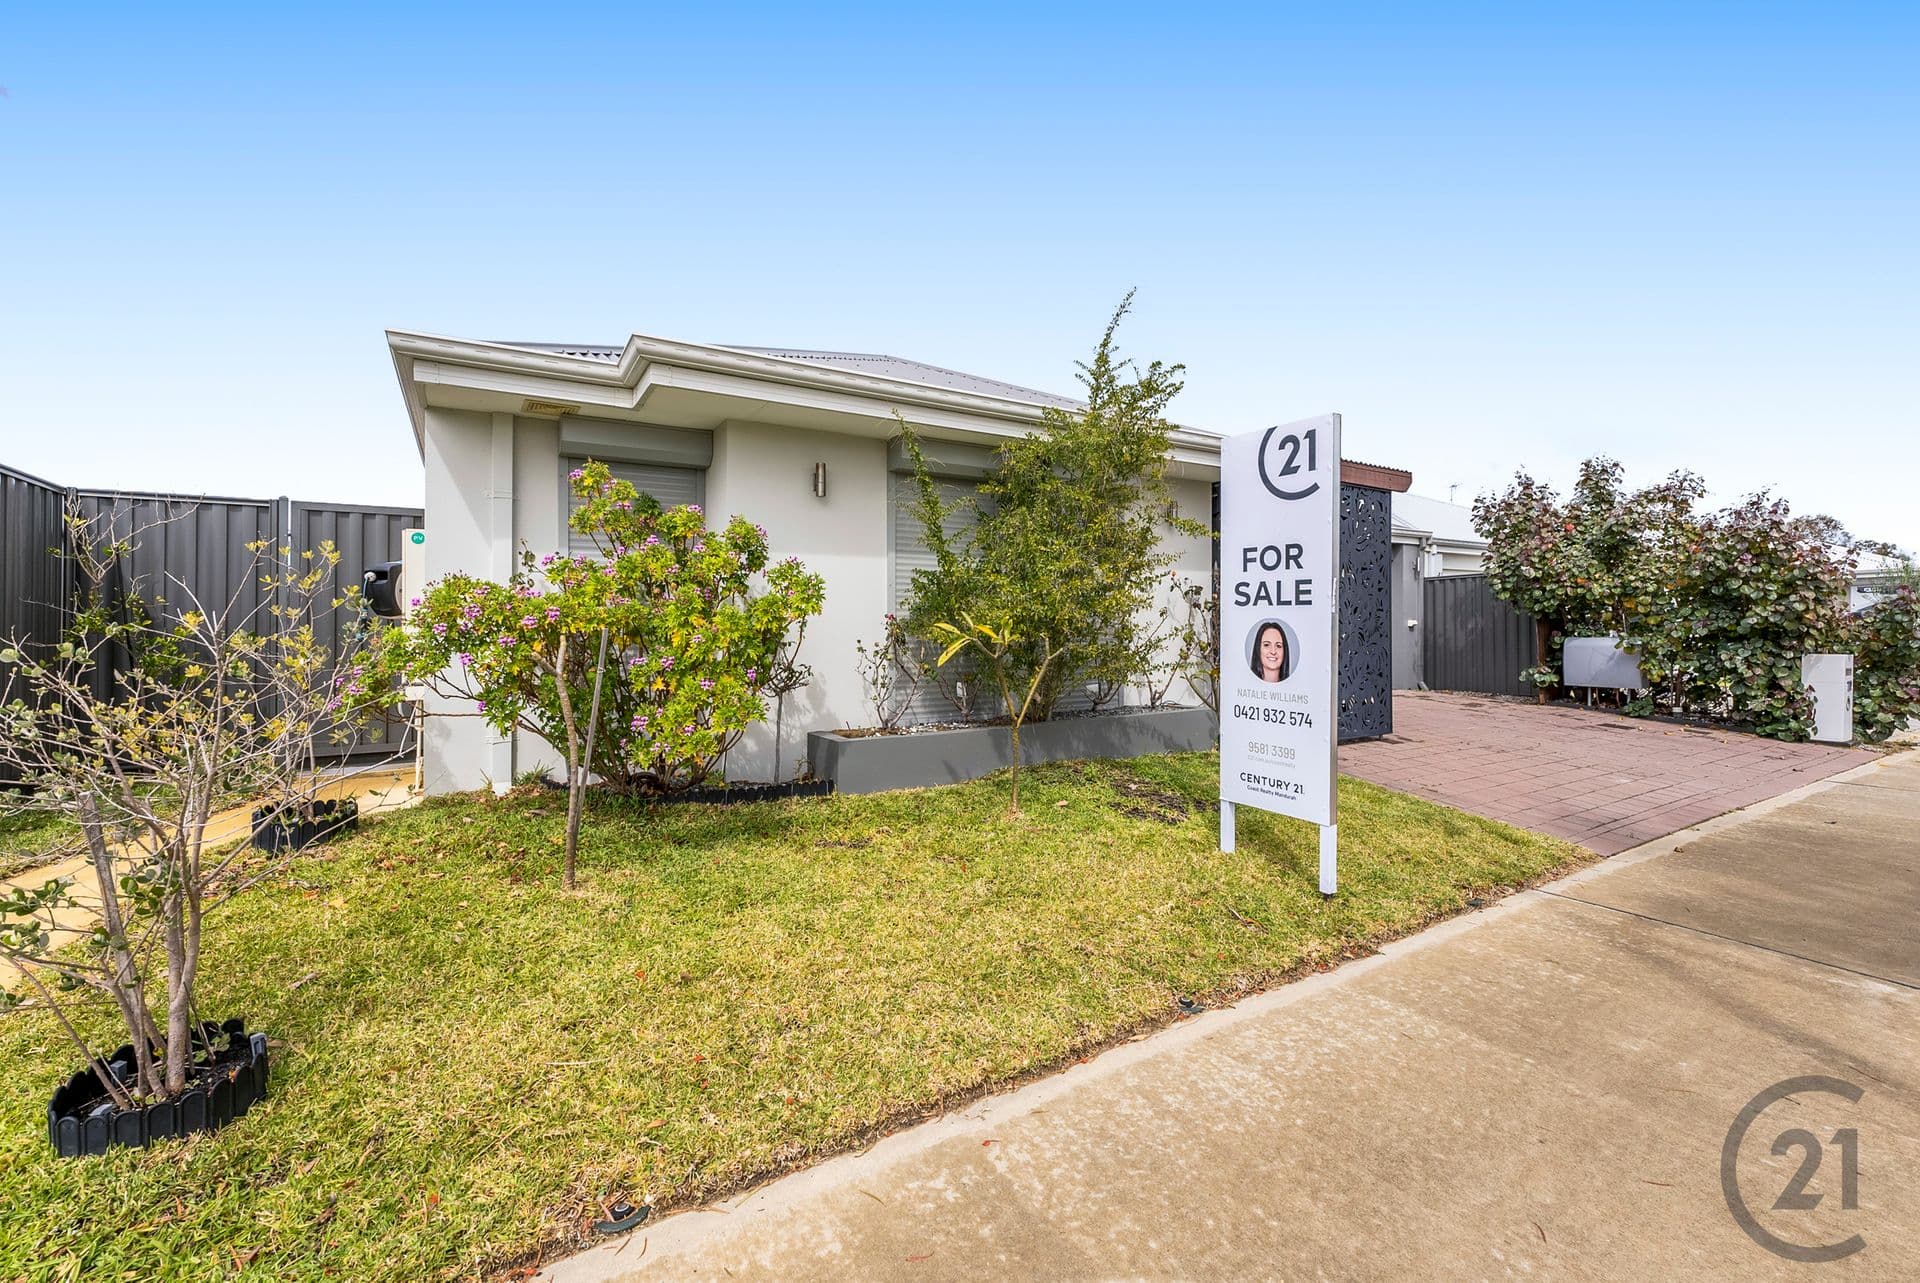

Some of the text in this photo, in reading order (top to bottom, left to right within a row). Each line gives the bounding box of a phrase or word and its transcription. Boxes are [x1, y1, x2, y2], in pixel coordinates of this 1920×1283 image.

[1242, 543, 1304, 572] FOR
[1234, 579, 1313, 607] SALE
[1237, 687, 1309, 705] NATALIE WILLIAMS
[1234, 704, 1313, 729] 0421 932 574
[1248, 741, 1296, 760] 9581 3399
[1240, 772, 1303, 794] CENTURY 21
